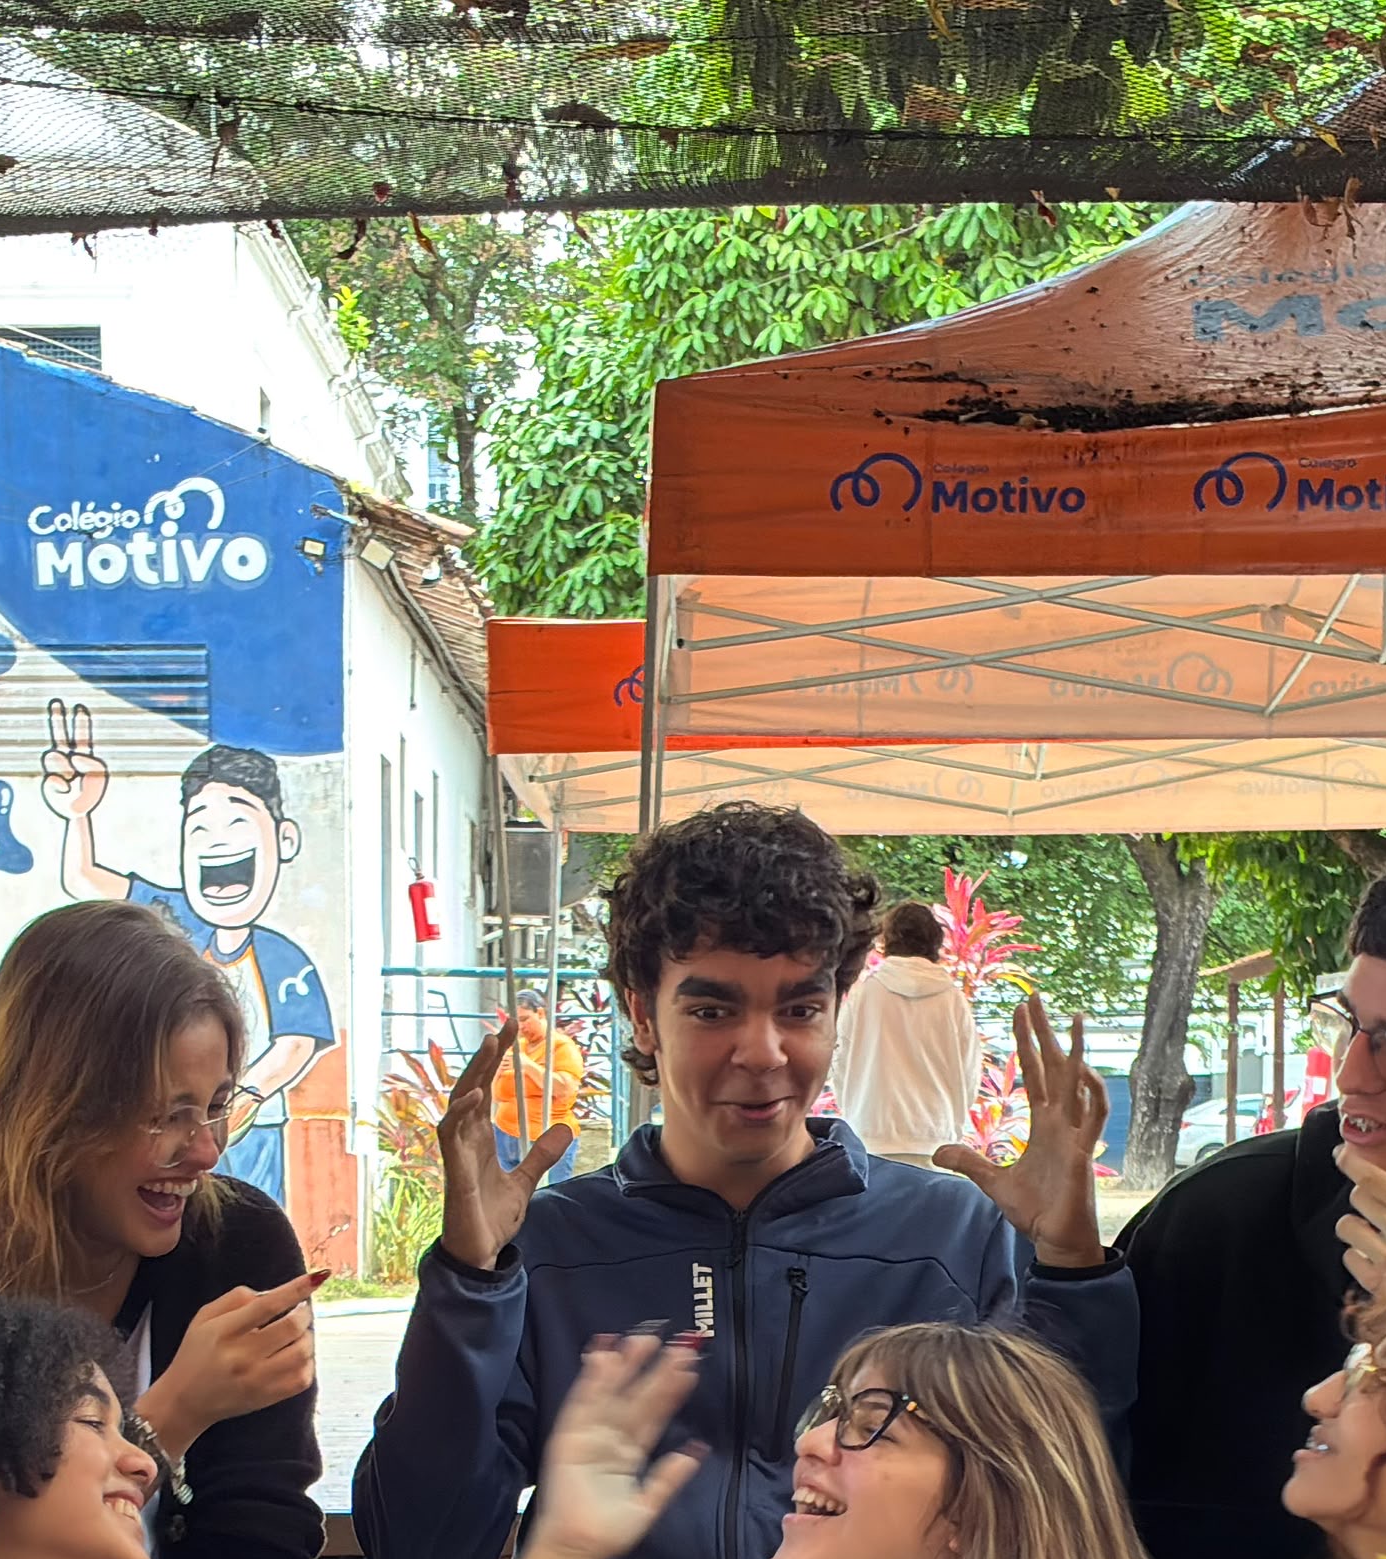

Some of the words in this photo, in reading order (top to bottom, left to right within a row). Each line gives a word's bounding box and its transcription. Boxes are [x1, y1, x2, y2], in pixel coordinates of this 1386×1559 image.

[27, 501, 141, 539] Colégio
[931, 475, 1086, 514] Motivo
[36, 520, 267, 588] Motivo
[692, 1262, 715, 1338] MILLET
